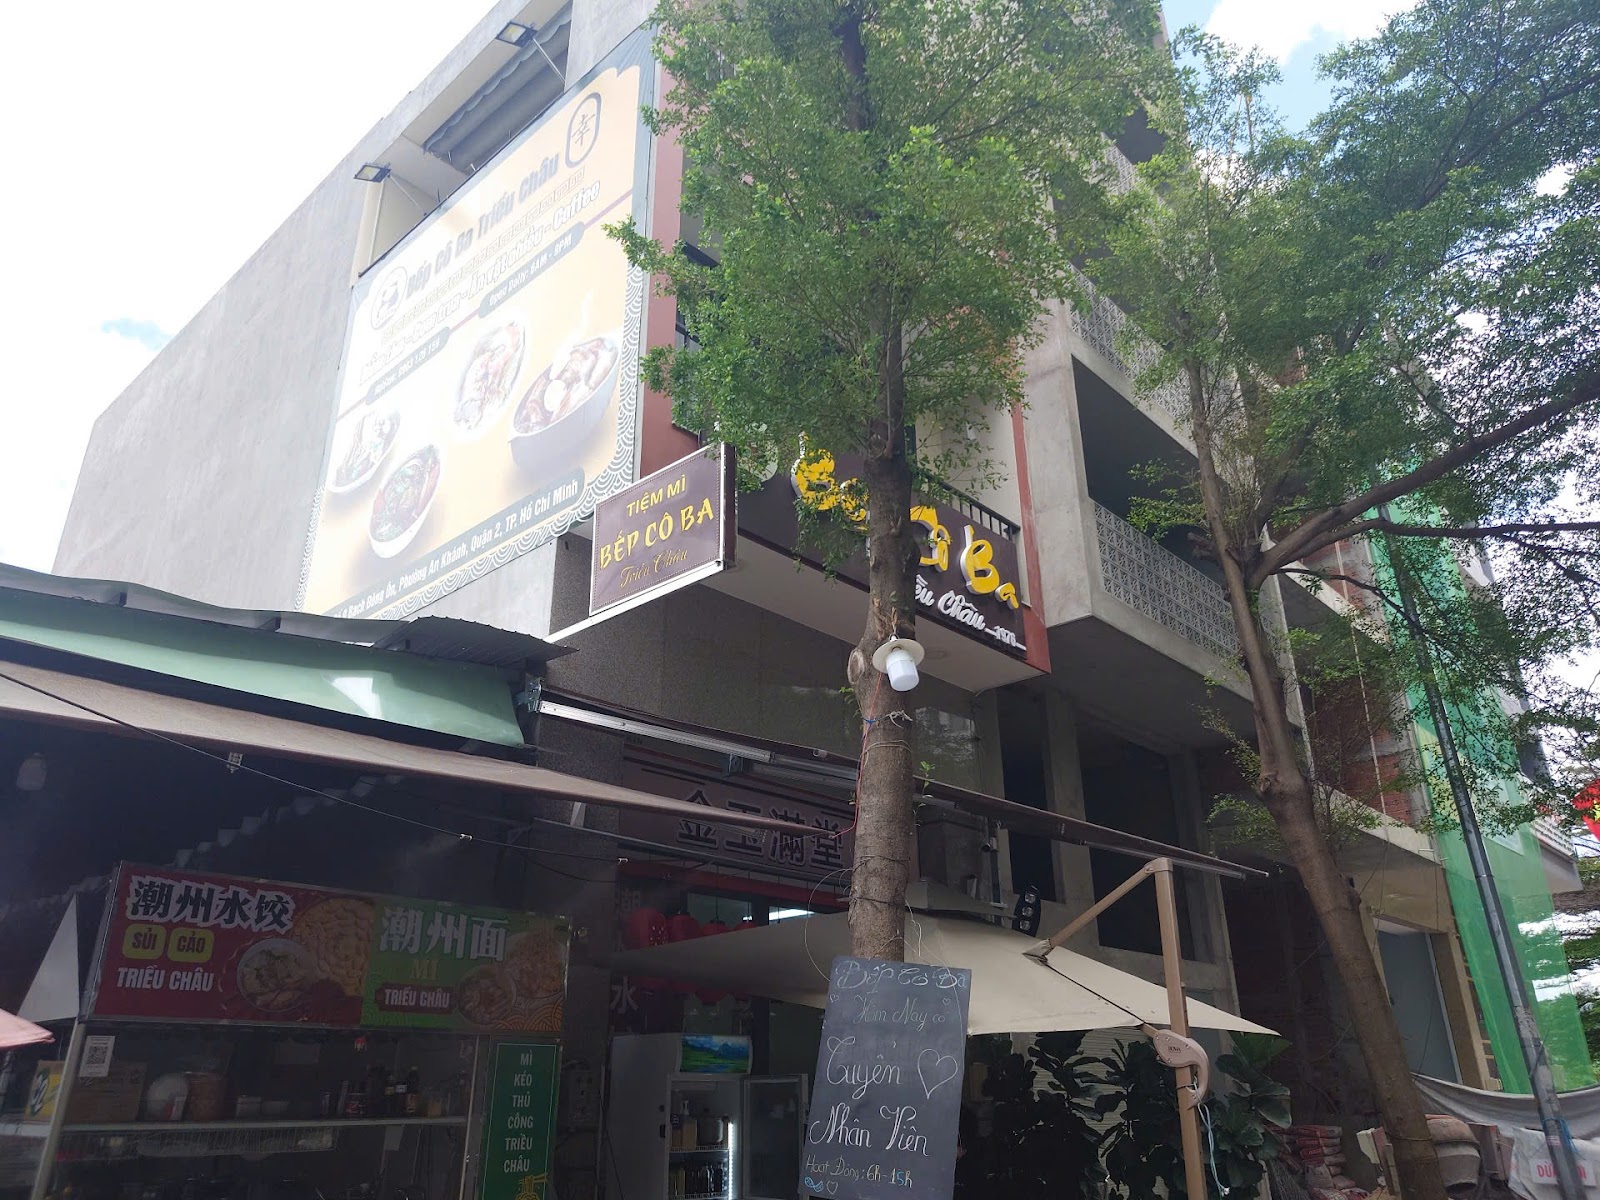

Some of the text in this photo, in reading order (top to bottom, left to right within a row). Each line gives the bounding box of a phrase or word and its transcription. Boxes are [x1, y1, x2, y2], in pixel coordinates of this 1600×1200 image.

[553, 179, 602, 232] Coffee
[627, 473, 688, 518] TIỆM MÌ
[428, 555, 440, 577] An
[441, 541, 469, 568] Khánh,
[470, 528, 493, 553] Quận
[492, 525, 503, 540] 2,
[505, 513, 518, 531] TP.
[519, 503, 534, 523] Hồ
[534, 493, 552, 517] Chí
[553, 478, 578, 506] Minh
[599, 497, 715, 570] BẾP CÔ BA
[960, 524, 1020, 611] Ba
[938, 589, 986, 631] Châu
[129, 878, 292, 931] 潮州水饺
[379, 905, 509, 962] 潮州面
[117, 964, 215, 992] TRIỀU CHÂU
[419, 987, 450, 1009] CHÂU
[891, 996, 928, 1032] Nay
[513, 1068, 533, 1087] KÉO
[520, 1050, 533, 1067] MÌ
[504, 1132, 533, 1151] TRIỀU
[507, 1112, 534, 1130] CÔNG
[809, 1102, 936, 1157] Nhân Viên
[503, 1154, 530, 1173] CHÂU
